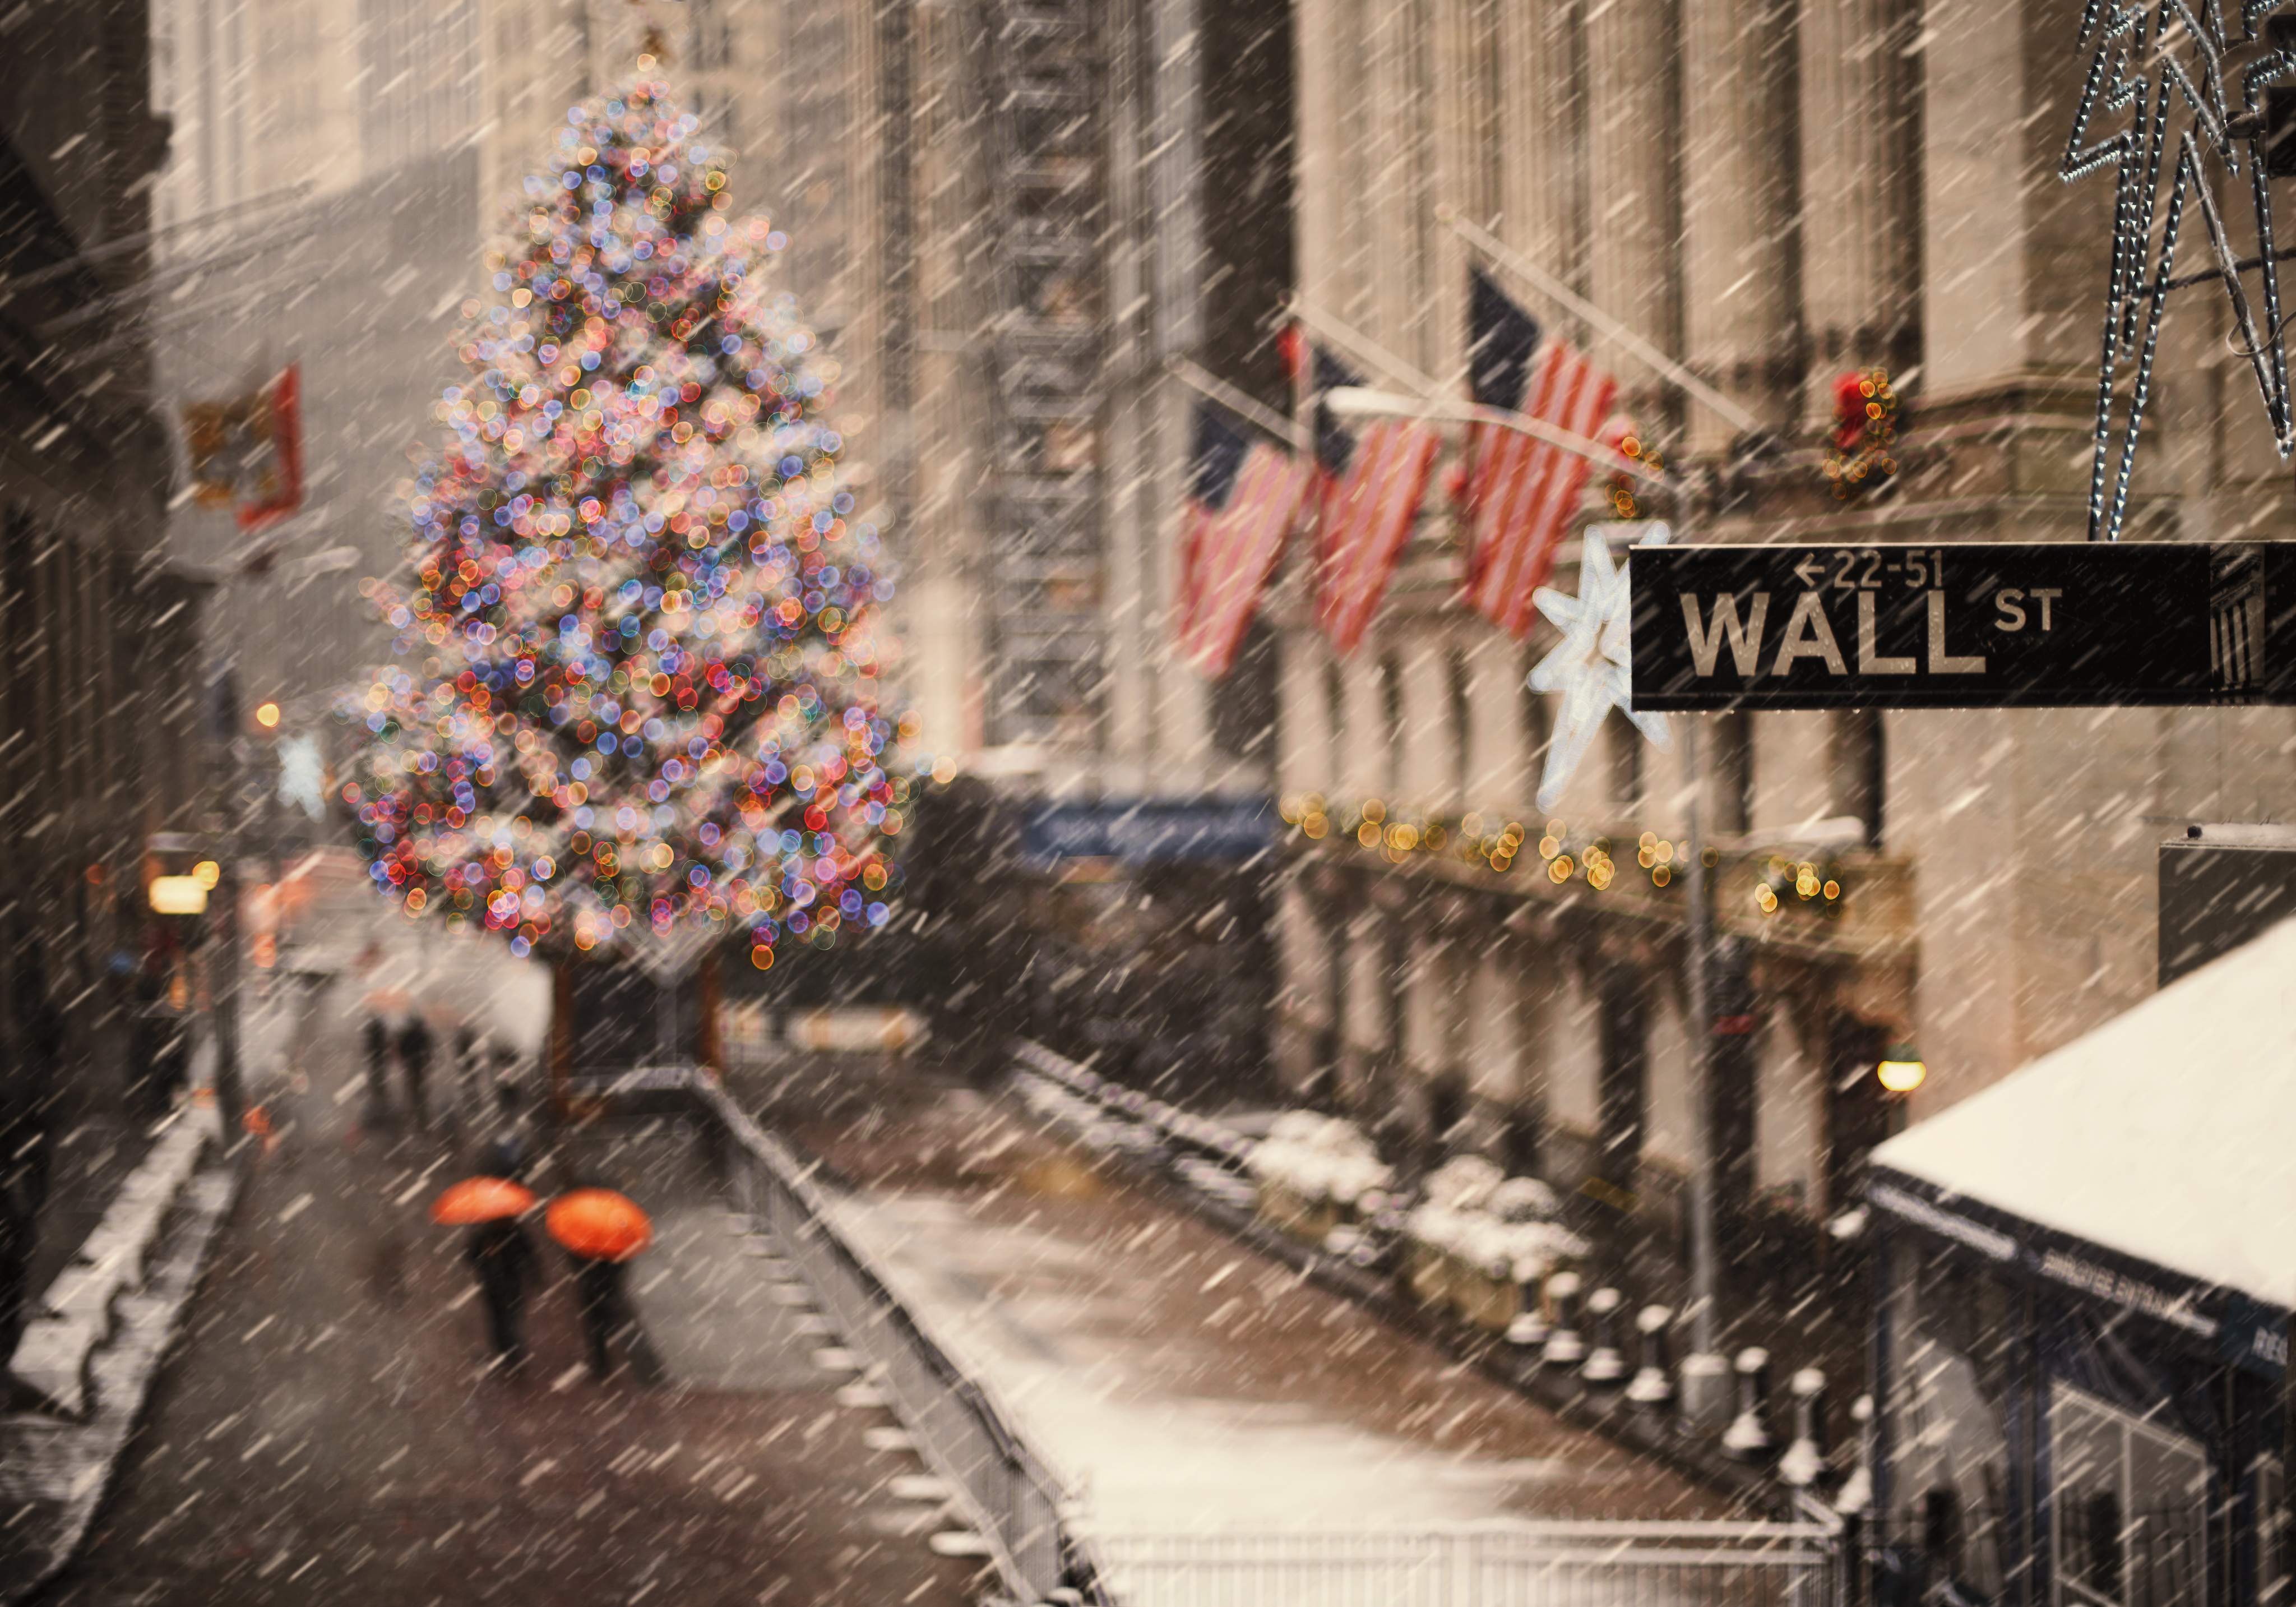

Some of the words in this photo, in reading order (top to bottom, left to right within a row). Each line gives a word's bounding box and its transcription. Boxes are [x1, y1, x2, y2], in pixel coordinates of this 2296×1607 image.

[1834, 549, 1942, 588] 22-51
[1680, 590, 1986, 676] WALL
[1994, 588, 2063, 631] ST
